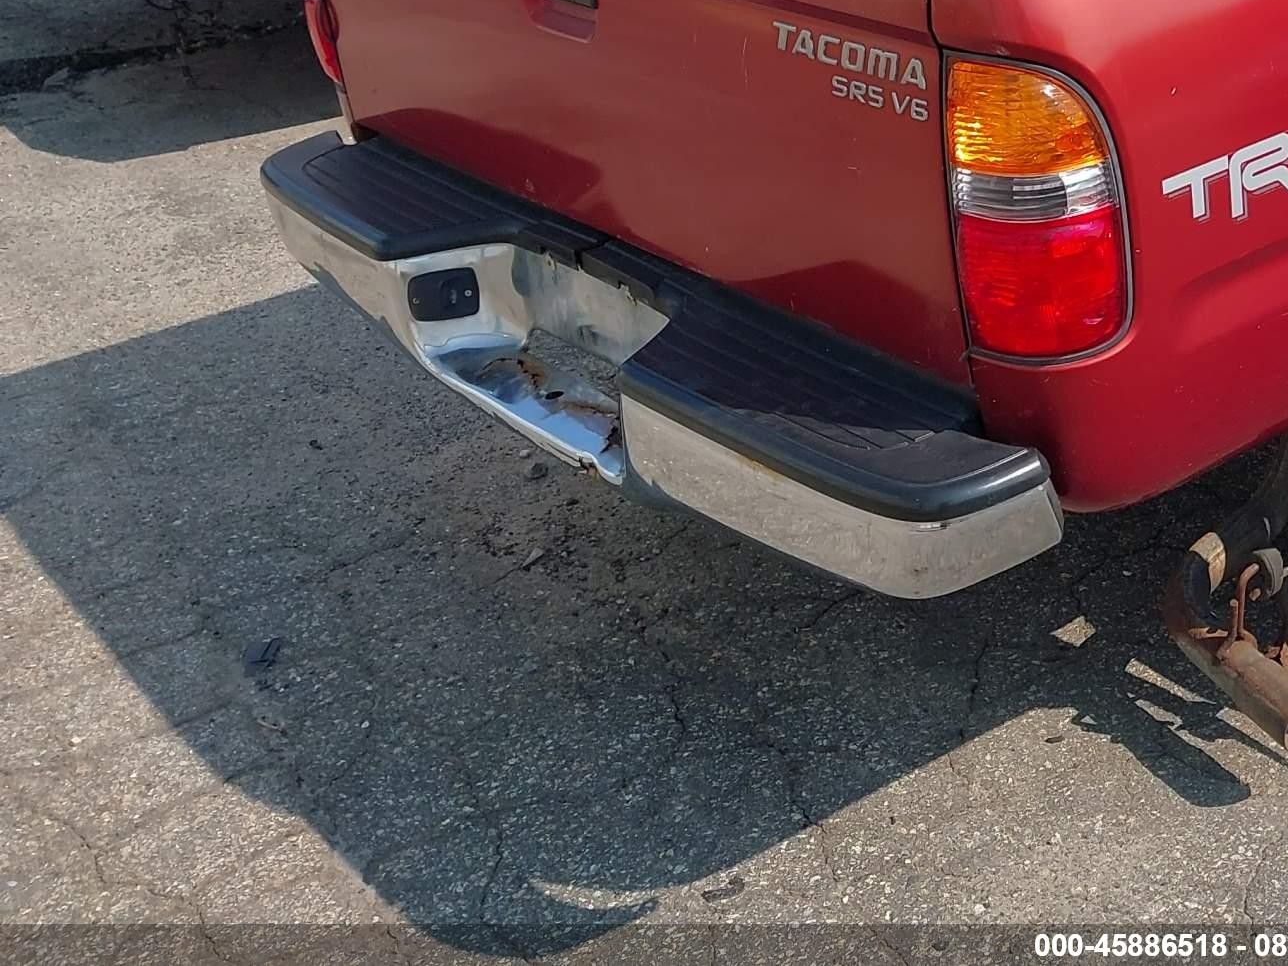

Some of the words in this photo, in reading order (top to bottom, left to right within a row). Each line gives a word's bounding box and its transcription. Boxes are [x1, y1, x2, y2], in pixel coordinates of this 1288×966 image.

[772, 20, 928, 91] TACOMA
[831, 75, 885, 109] SR5
[891, 91, 929, 122] V6
